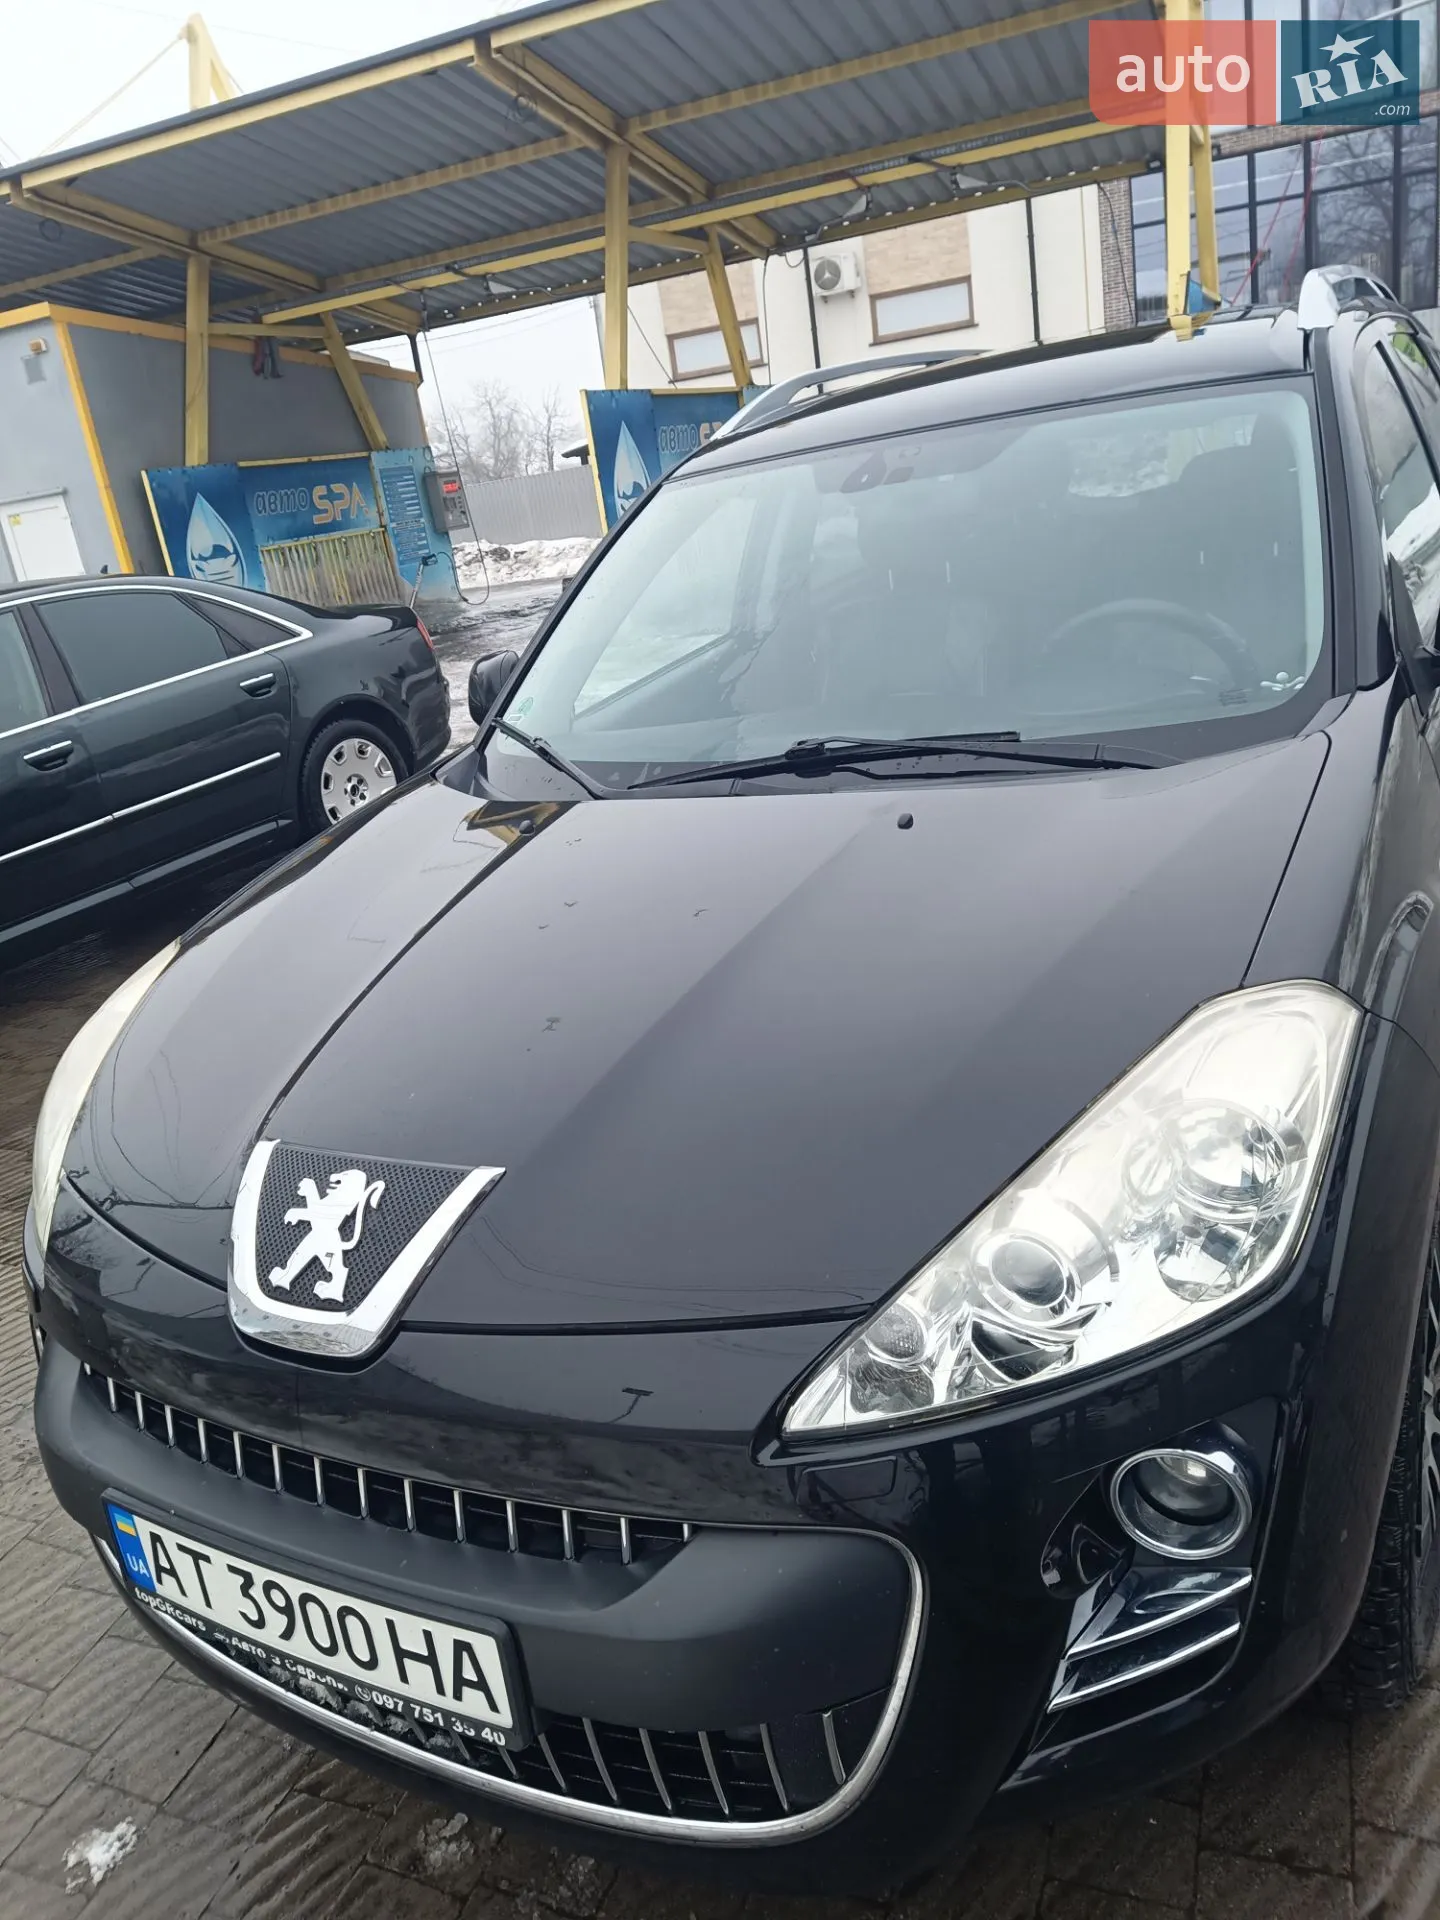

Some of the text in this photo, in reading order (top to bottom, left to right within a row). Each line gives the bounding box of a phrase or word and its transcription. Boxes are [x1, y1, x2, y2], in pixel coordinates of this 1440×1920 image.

[312, 481, 370, 525] SPA
[126, 1552, 151, 1578] UA
[149, 1531, 501, 1715] AT 3900 HA
[370, 1691, 404, 1713] 097
[409, 1702, 445, 1727] 751
[481, 1726, 507, 1747] 40
